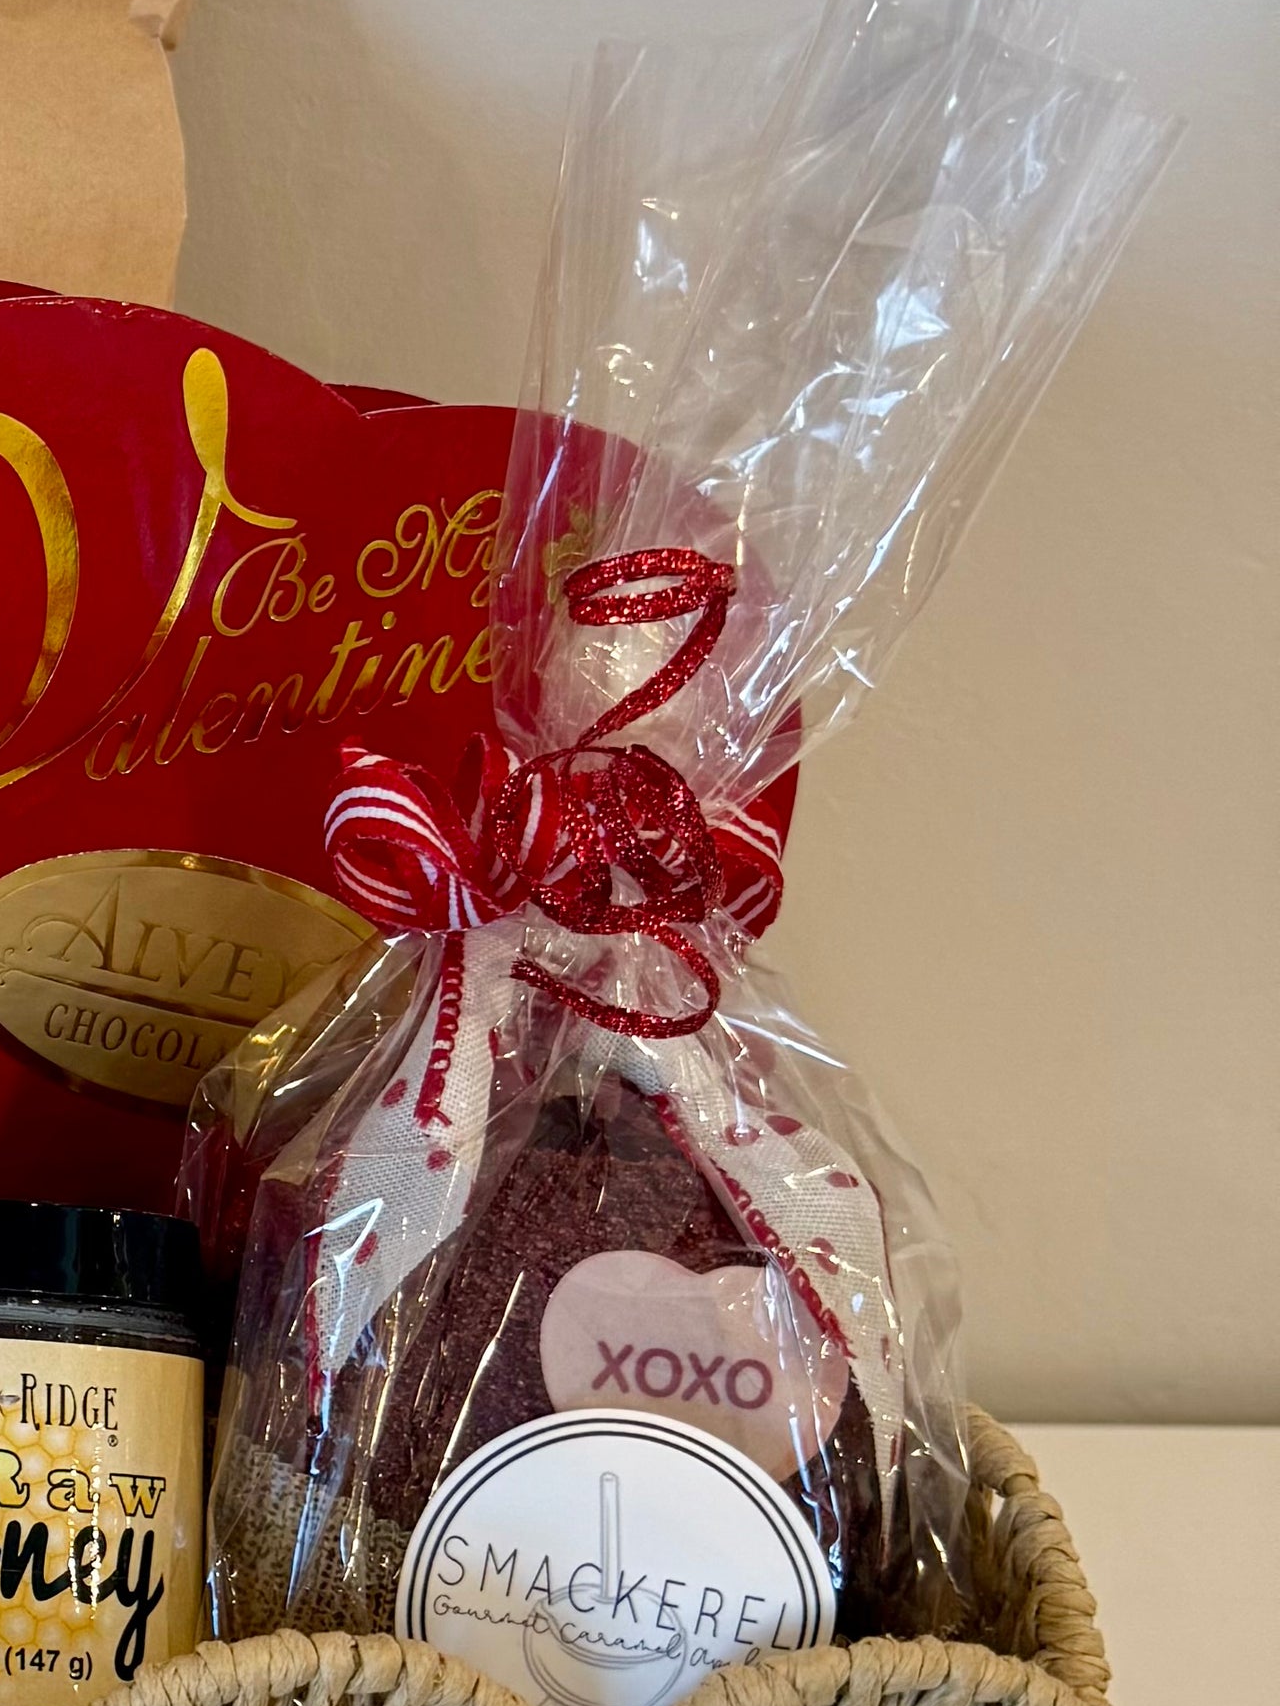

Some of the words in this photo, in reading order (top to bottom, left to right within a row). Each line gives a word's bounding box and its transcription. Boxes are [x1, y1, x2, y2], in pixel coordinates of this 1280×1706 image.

[211, 532, 337, 637] Be
[356, 489, 507, 607] My
[20, 1372, 119, 1431] RIDGE
[590, 1340, 774, 1411] XOXO
[437, 1534, 796, 1652] SMACKEREL
[4, 1645, 61, 1676] (147
[68, 1651, 94, 1681] g)
